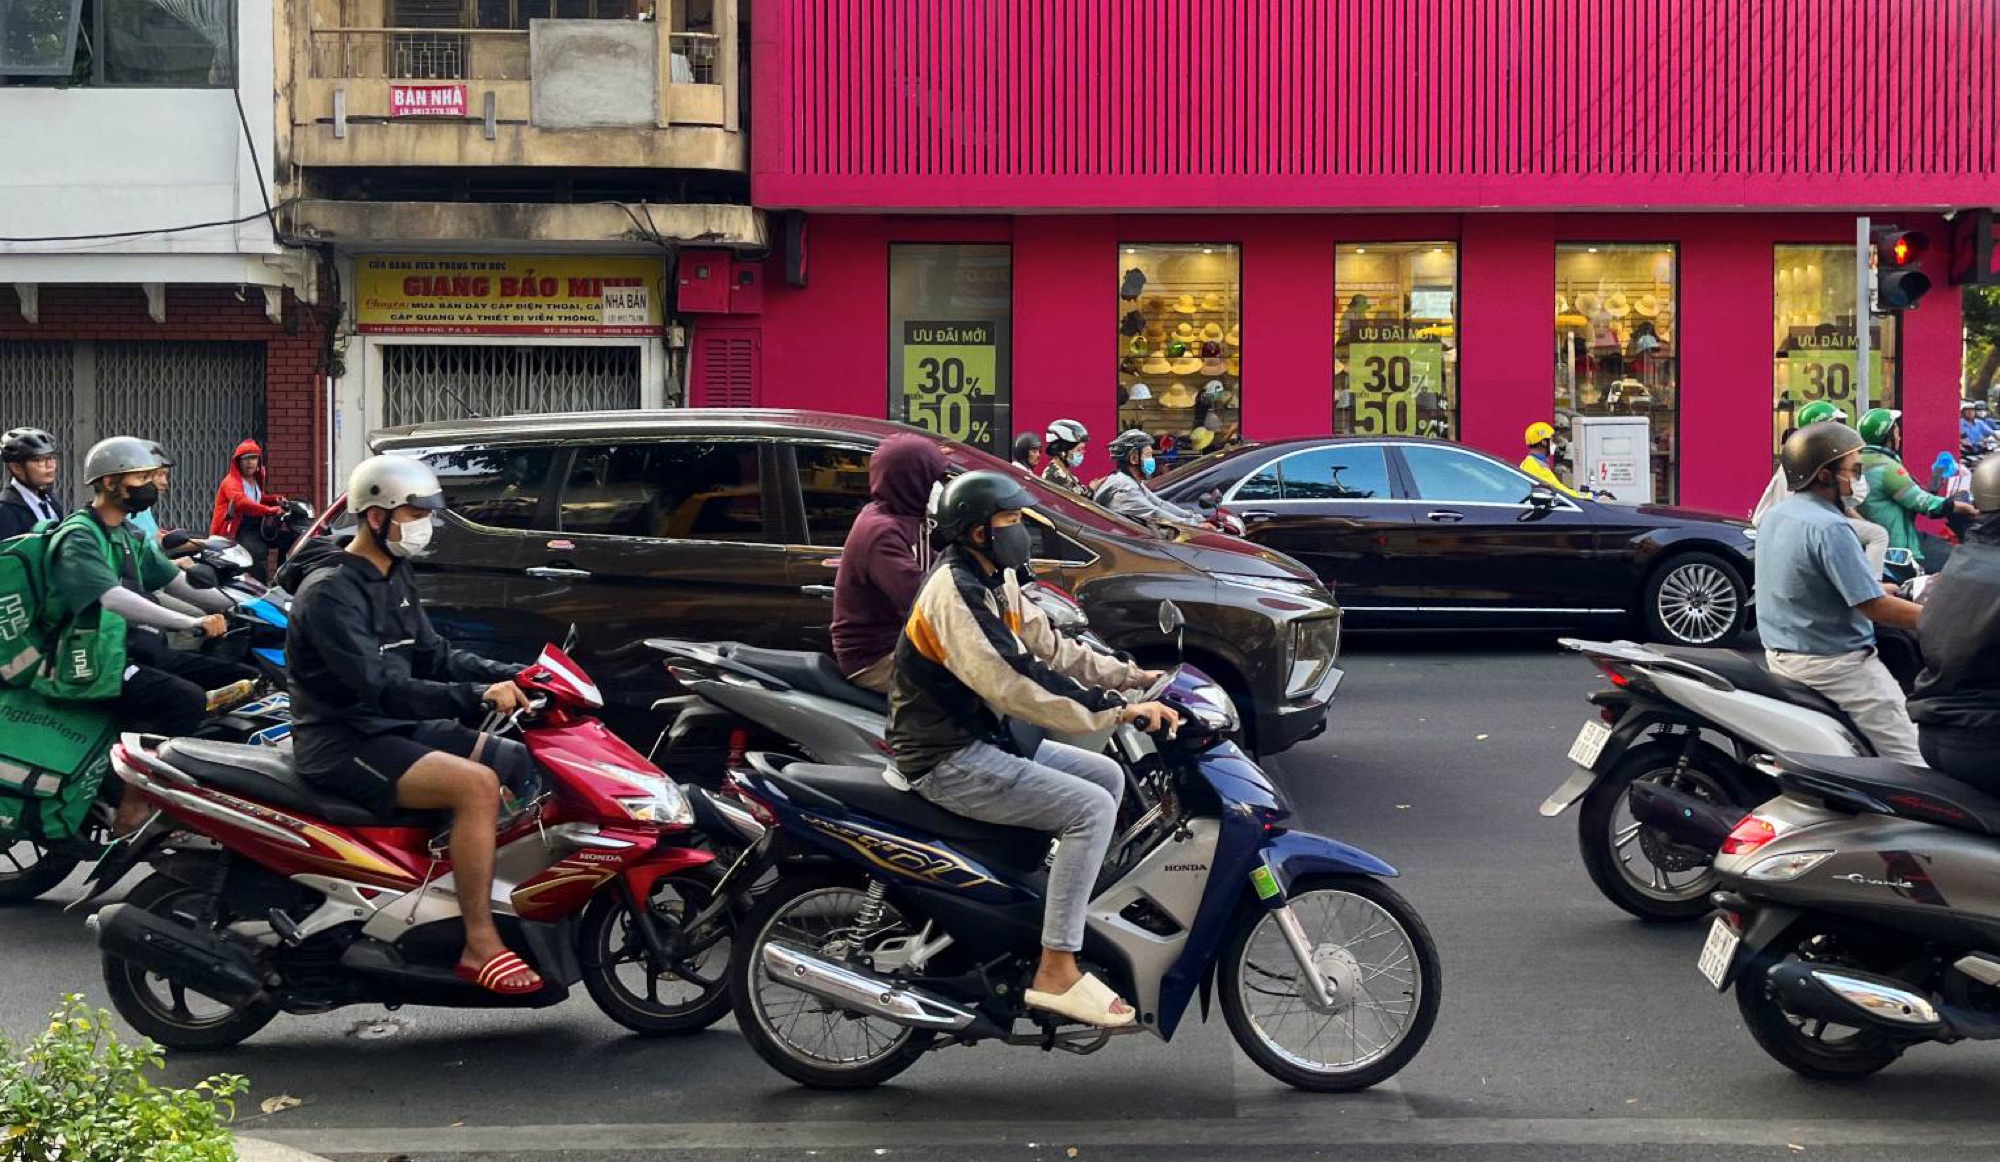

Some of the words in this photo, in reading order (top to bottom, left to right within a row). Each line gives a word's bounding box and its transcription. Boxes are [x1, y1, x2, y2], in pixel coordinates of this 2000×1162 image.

[936, 327, 958, 342] ĐÃI
[962, 327, 986, 342] MỚI
[580, 853, 623, 862] HONDA
